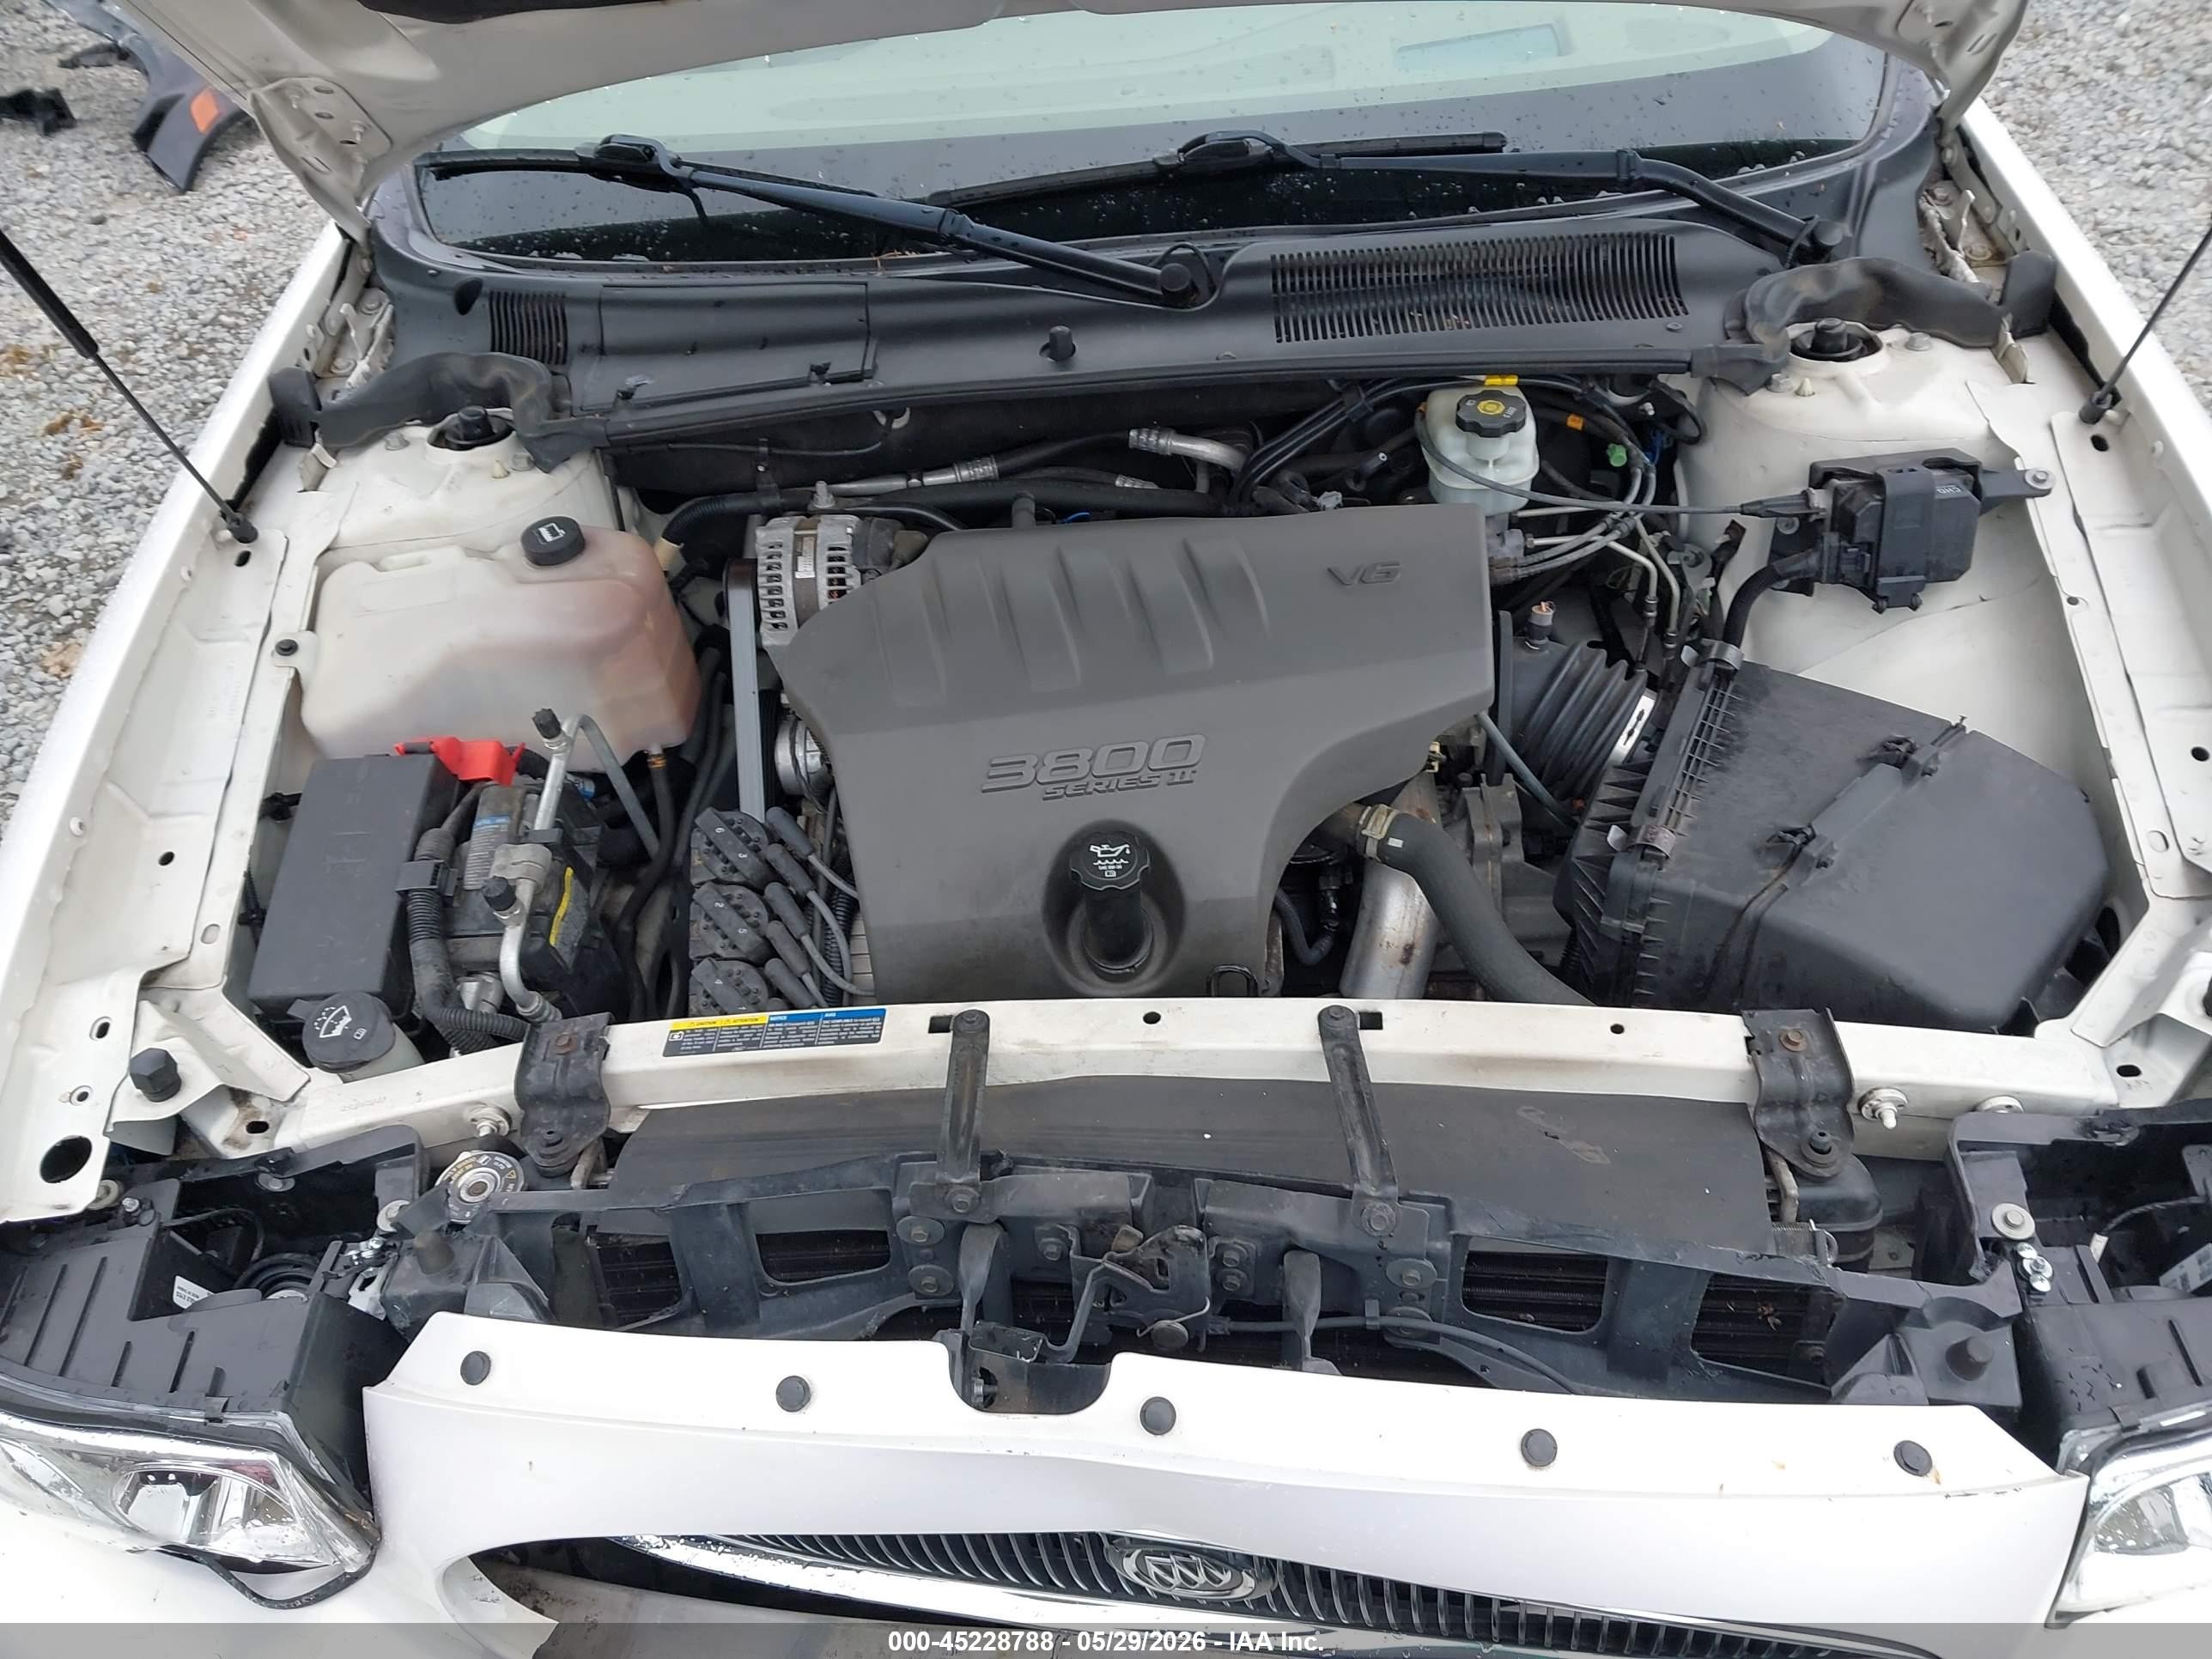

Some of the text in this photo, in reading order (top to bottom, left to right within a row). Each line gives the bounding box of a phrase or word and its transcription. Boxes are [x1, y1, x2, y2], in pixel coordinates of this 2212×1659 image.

[1327, 562, 1402, 586] V6
[981, 734, 1206, 793] 3800
[1042, 775, 1160, 800] SERIES
